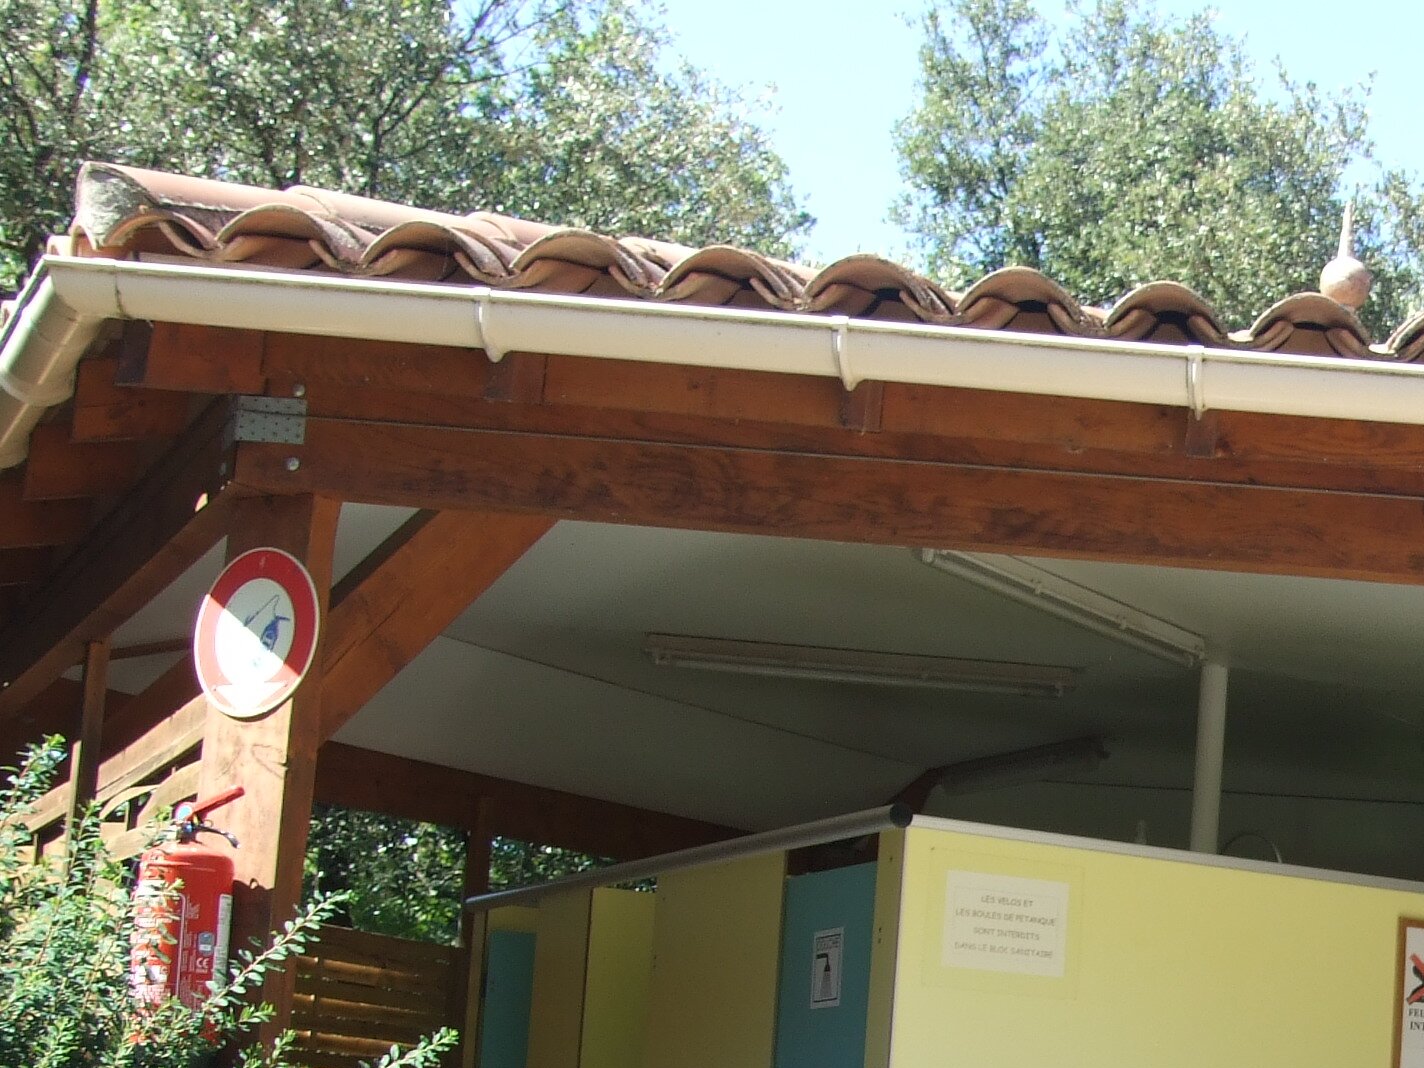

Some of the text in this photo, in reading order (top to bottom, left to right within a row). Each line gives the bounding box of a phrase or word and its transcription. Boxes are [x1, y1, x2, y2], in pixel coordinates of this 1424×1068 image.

[981, 895, 995, 904] LES
[1023, 899, 1034, 908] ET
[955, 908, 969, 917] LES
[972, 910, 1001, 920] BOULES
[1003, 913, 1014, 922] DE
[974, 927, 1040, 941] SONT INTERDITS
[954, 941, 1053, 959] DANS LE BLOC SANITAIRE
